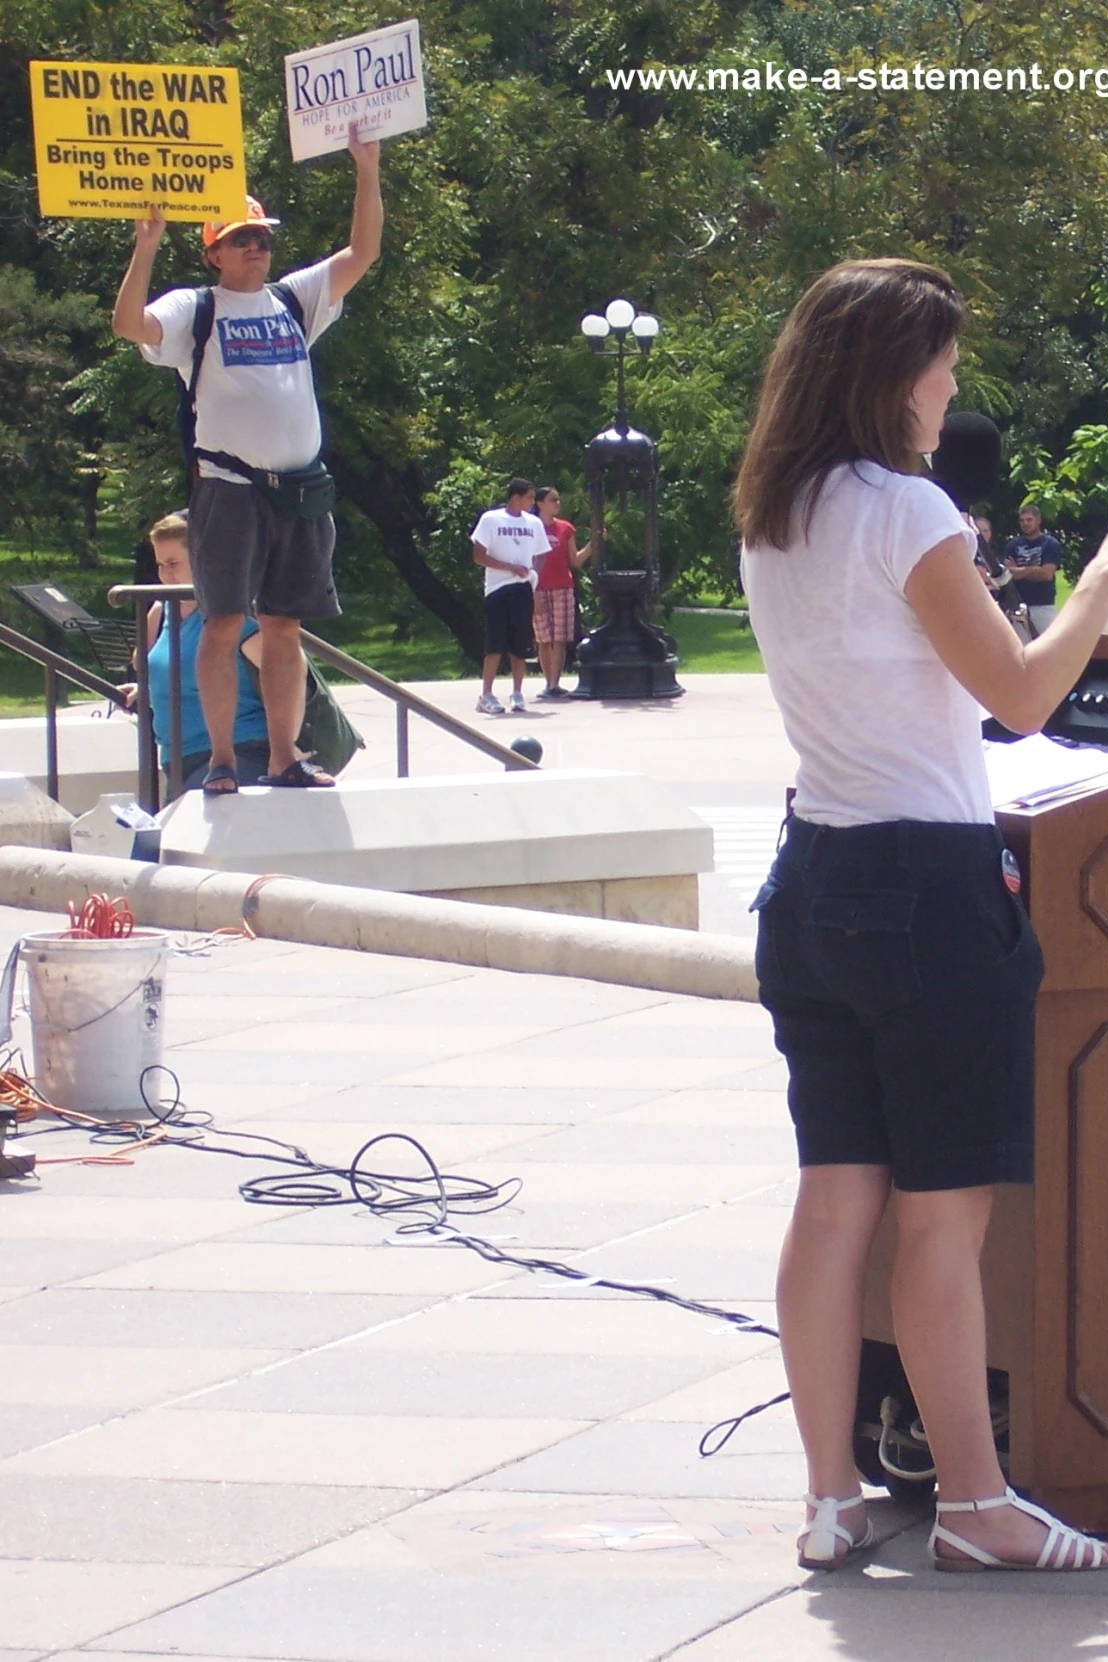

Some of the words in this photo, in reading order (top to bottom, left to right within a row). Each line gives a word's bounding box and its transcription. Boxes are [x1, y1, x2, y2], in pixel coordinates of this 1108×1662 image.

[43, 69, 100, 99] END
[110, 72, 154, 101] the
[162, 73, 227, 104] WAR
[292, 64, 348, 111] Ron
[354, 33, 416, 94] Paul
[302, 109, 330, 127] HOPE
[337, 101, 358, 118] FOR
[364, 86, 411, 110] AMERICA
[324, 124, 336, 136] Be
[339, 122, 345, 132] a
[371, 111, 381, 125] of
[384, 108, 392, 121] it
[86, 107, 111, 136] in
[120, 108, 190, 141] IRAQ
[47, 145, 106, 170] Bring
[114, 148, 150, 166] the
[157, 148, 234, 174] Troops
[79, 171, 144, 191] Home
[152, 173, 205, 194] NOW
[498, 527, 534, 537] FOOTBALL
